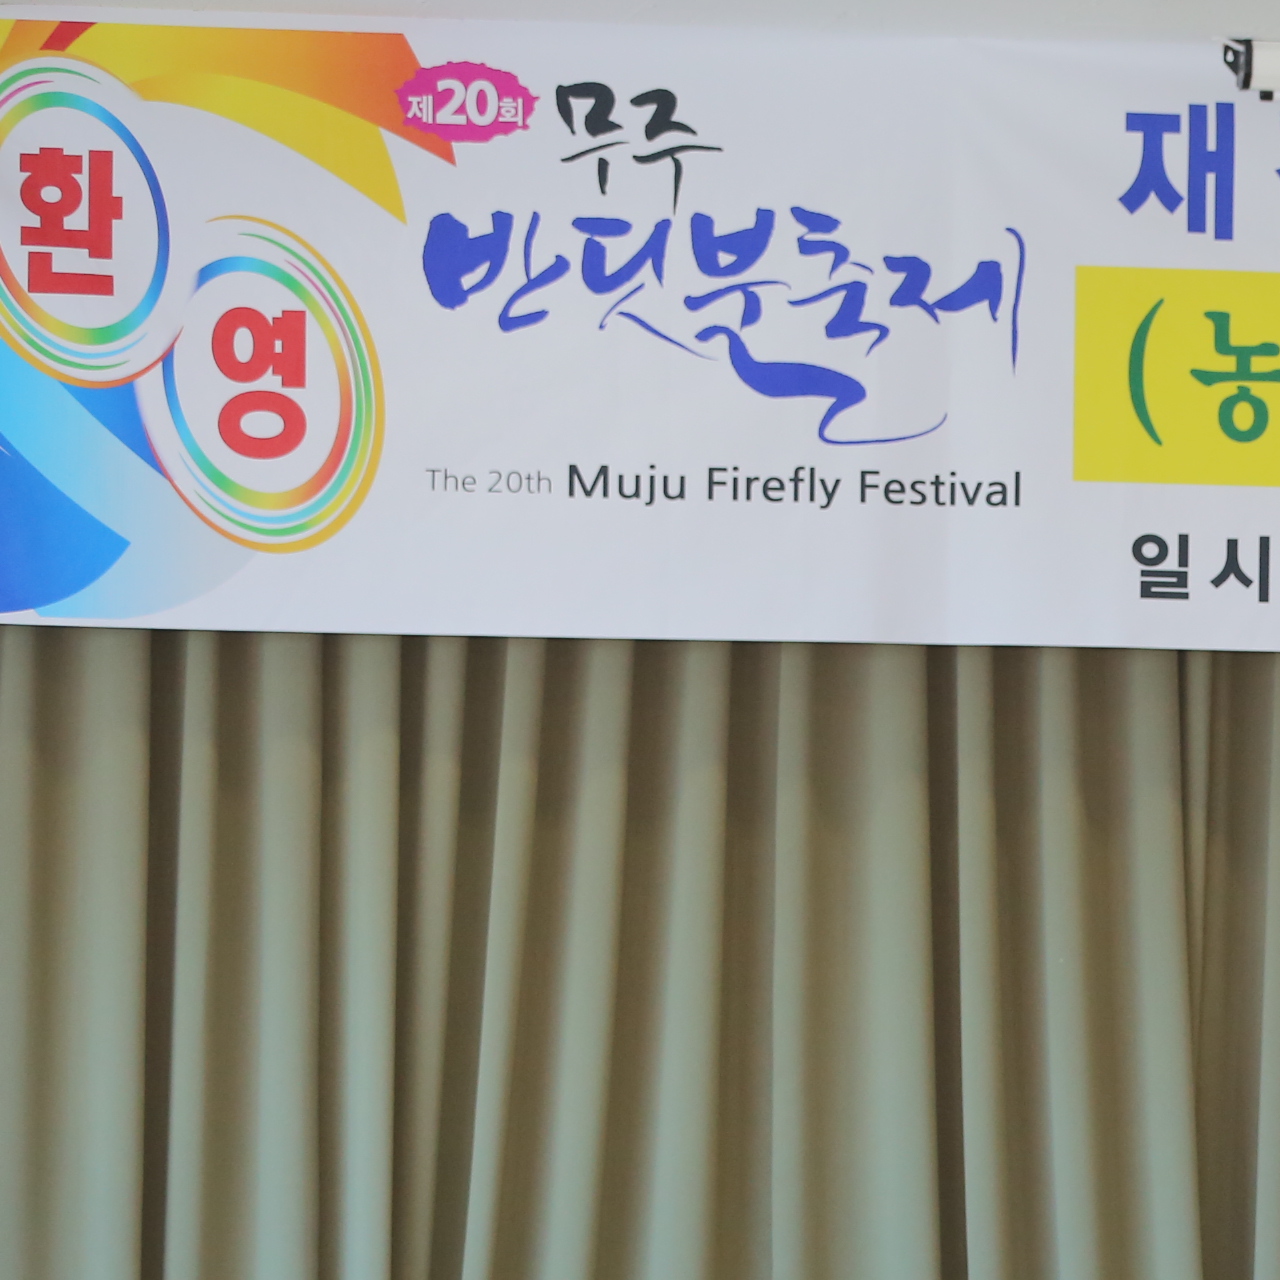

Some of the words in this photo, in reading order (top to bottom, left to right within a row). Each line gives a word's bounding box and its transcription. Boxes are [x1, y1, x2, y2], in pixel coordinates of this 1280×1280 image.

[406, 78, 526, 127] 제20회
[556, 82, 724, 217] 무주
[19, 147, 123, 297] 환
[211, 306, 307, 460] 영
[422, 207, 1026, 446] 반딧불축제
[426, 468, 477, 494] The
[487, 470, 553, 495] 20th
[567, 464, 687, 507] Muju
[706, 466, 842, 510] Firefly
[859, 470, 1022, 508] Festival
